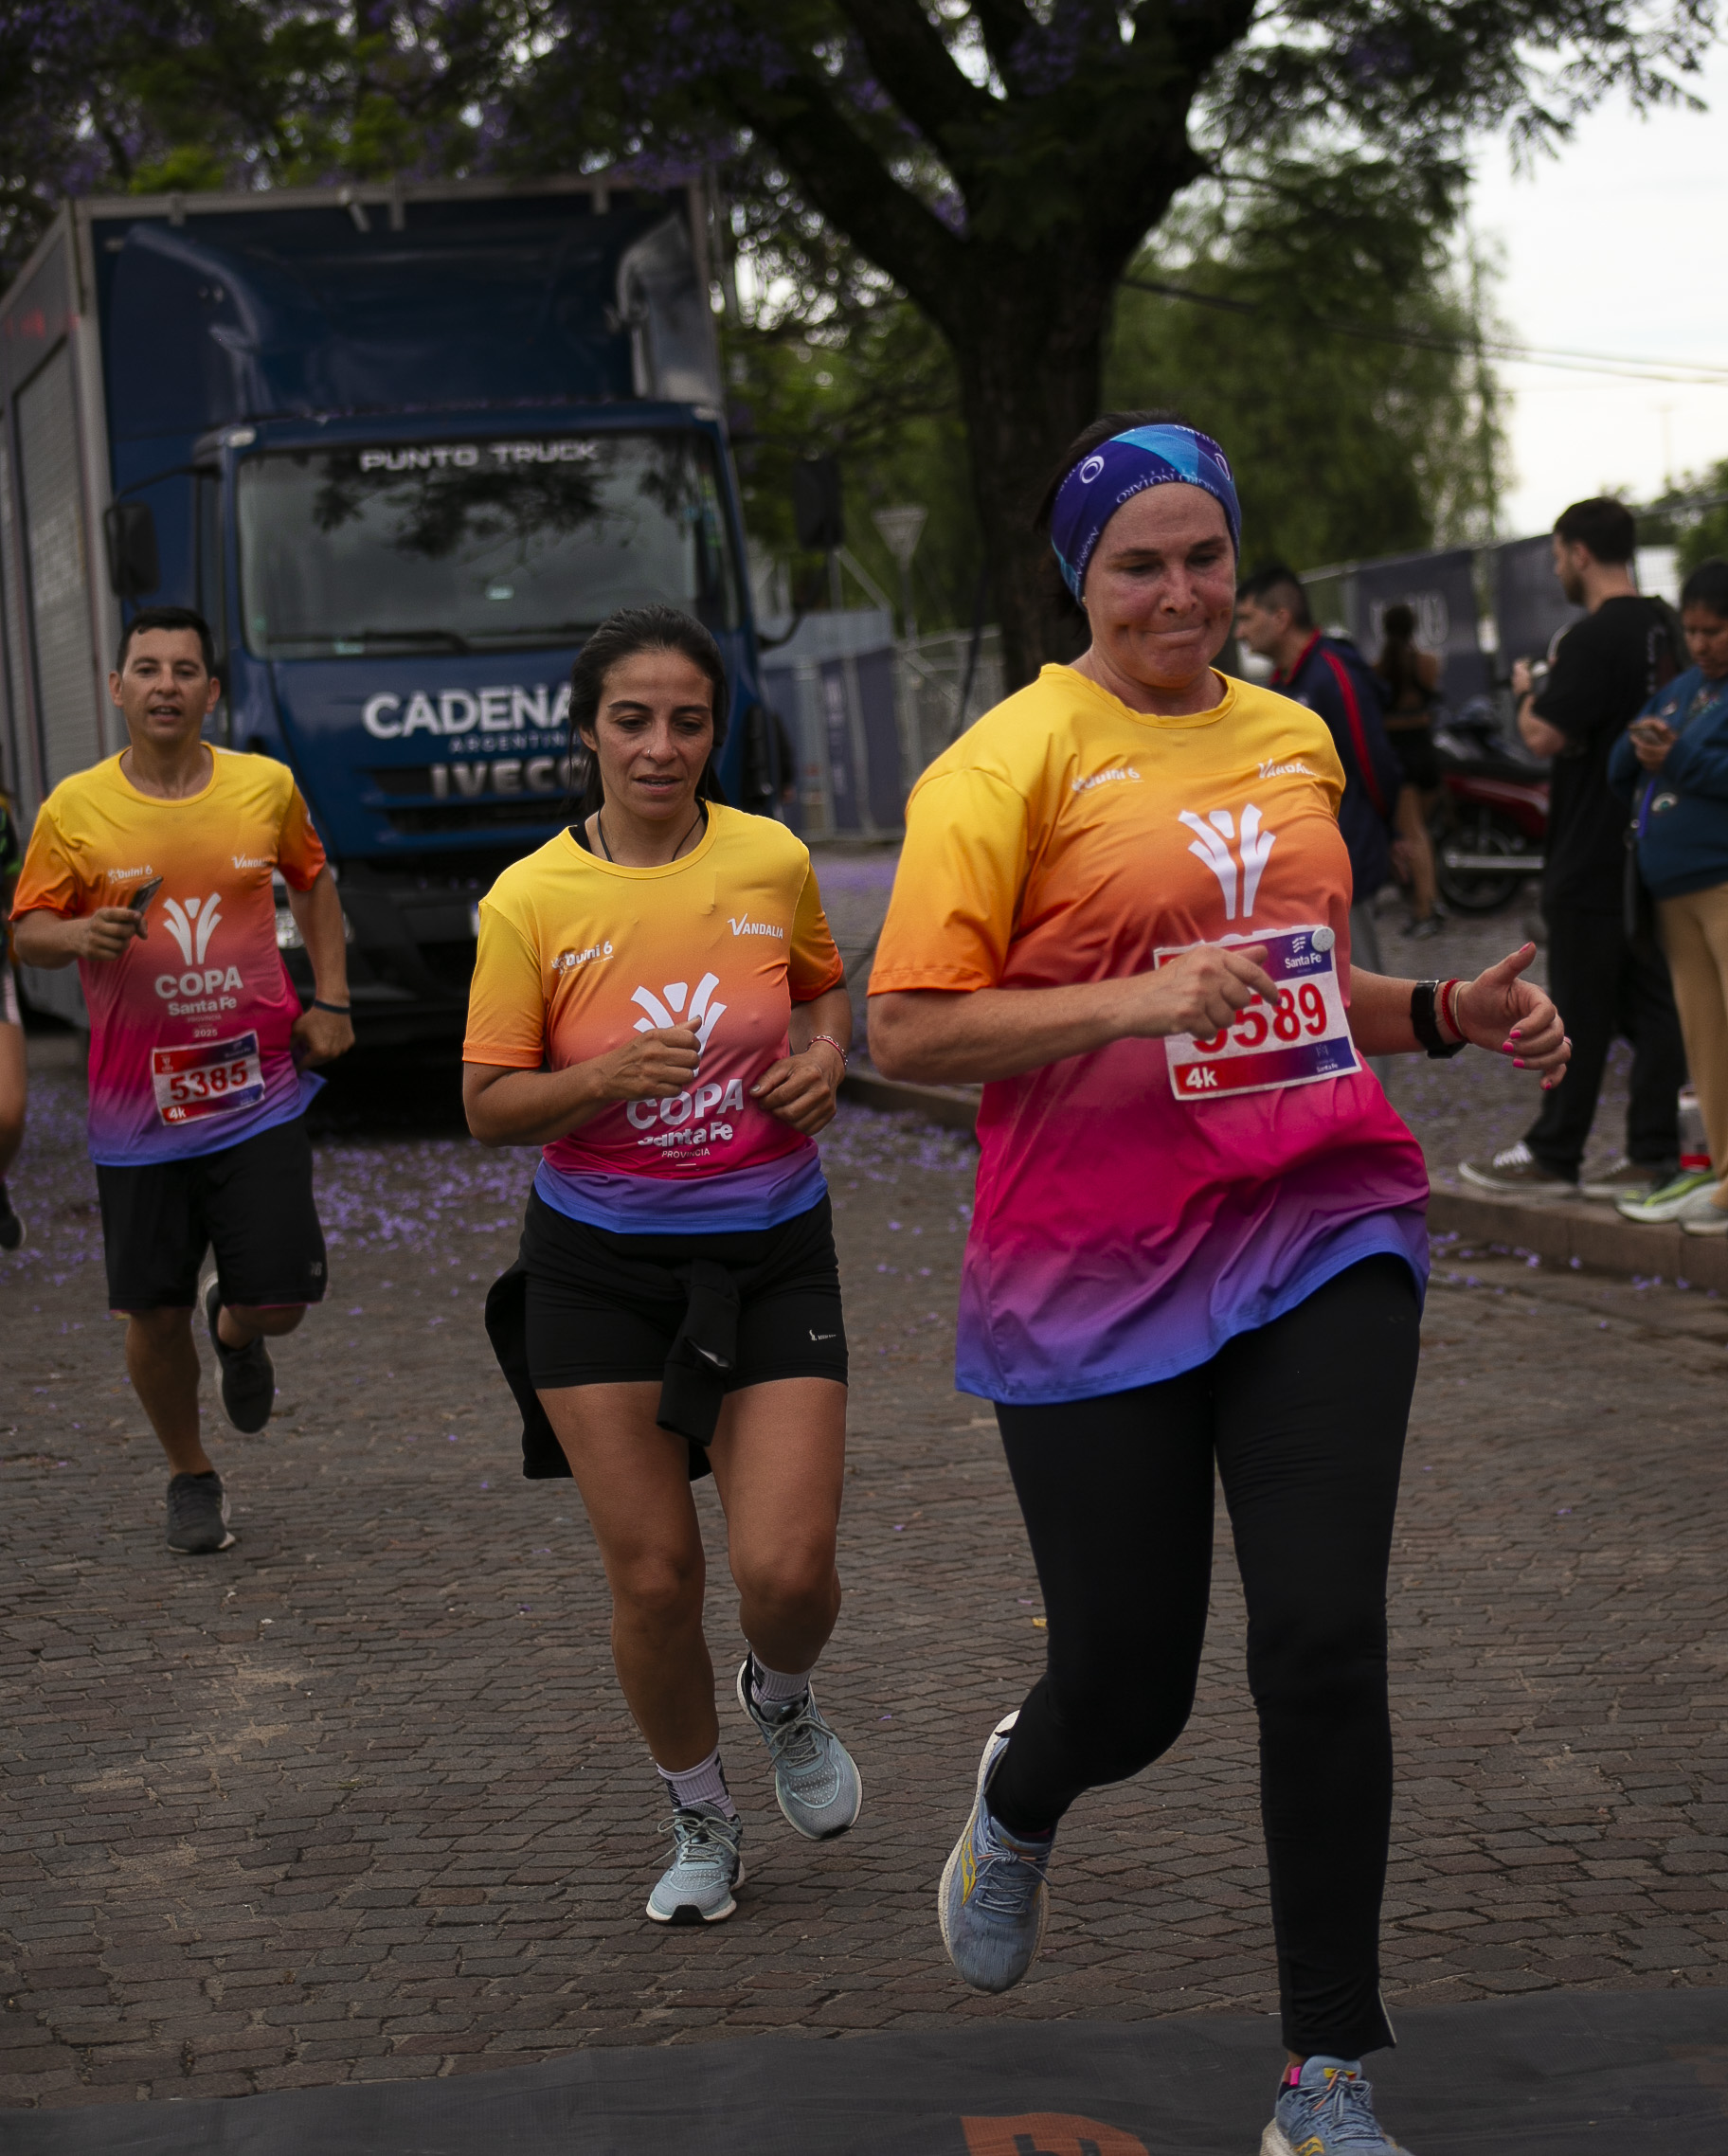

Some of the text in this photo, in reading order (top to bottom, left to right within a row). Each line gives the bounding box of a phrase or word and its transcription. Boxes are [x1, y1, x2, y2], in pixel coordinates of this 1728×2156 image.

[359, 440, 600, 472] PUNTO TRUCK
[566, 943, 601, 966] Quini
[603, 940, 613, 955] 6
[1285, 952, 1323, 969] Santa Fe
[154, 964, 244, 999] COPA
[168, 996, 238, 1016] Santa Fe
[171, 1060, 248, 1102] 5385
[1185, 1066, 1218, 1089] 4k
[168, 1106, 188, 1120] 4k
[626, 1078, 744, 1130] COPA
[710, 1121, 733, 1141] Fe
[661, 1147, 711, 1159] PROVINCIA
